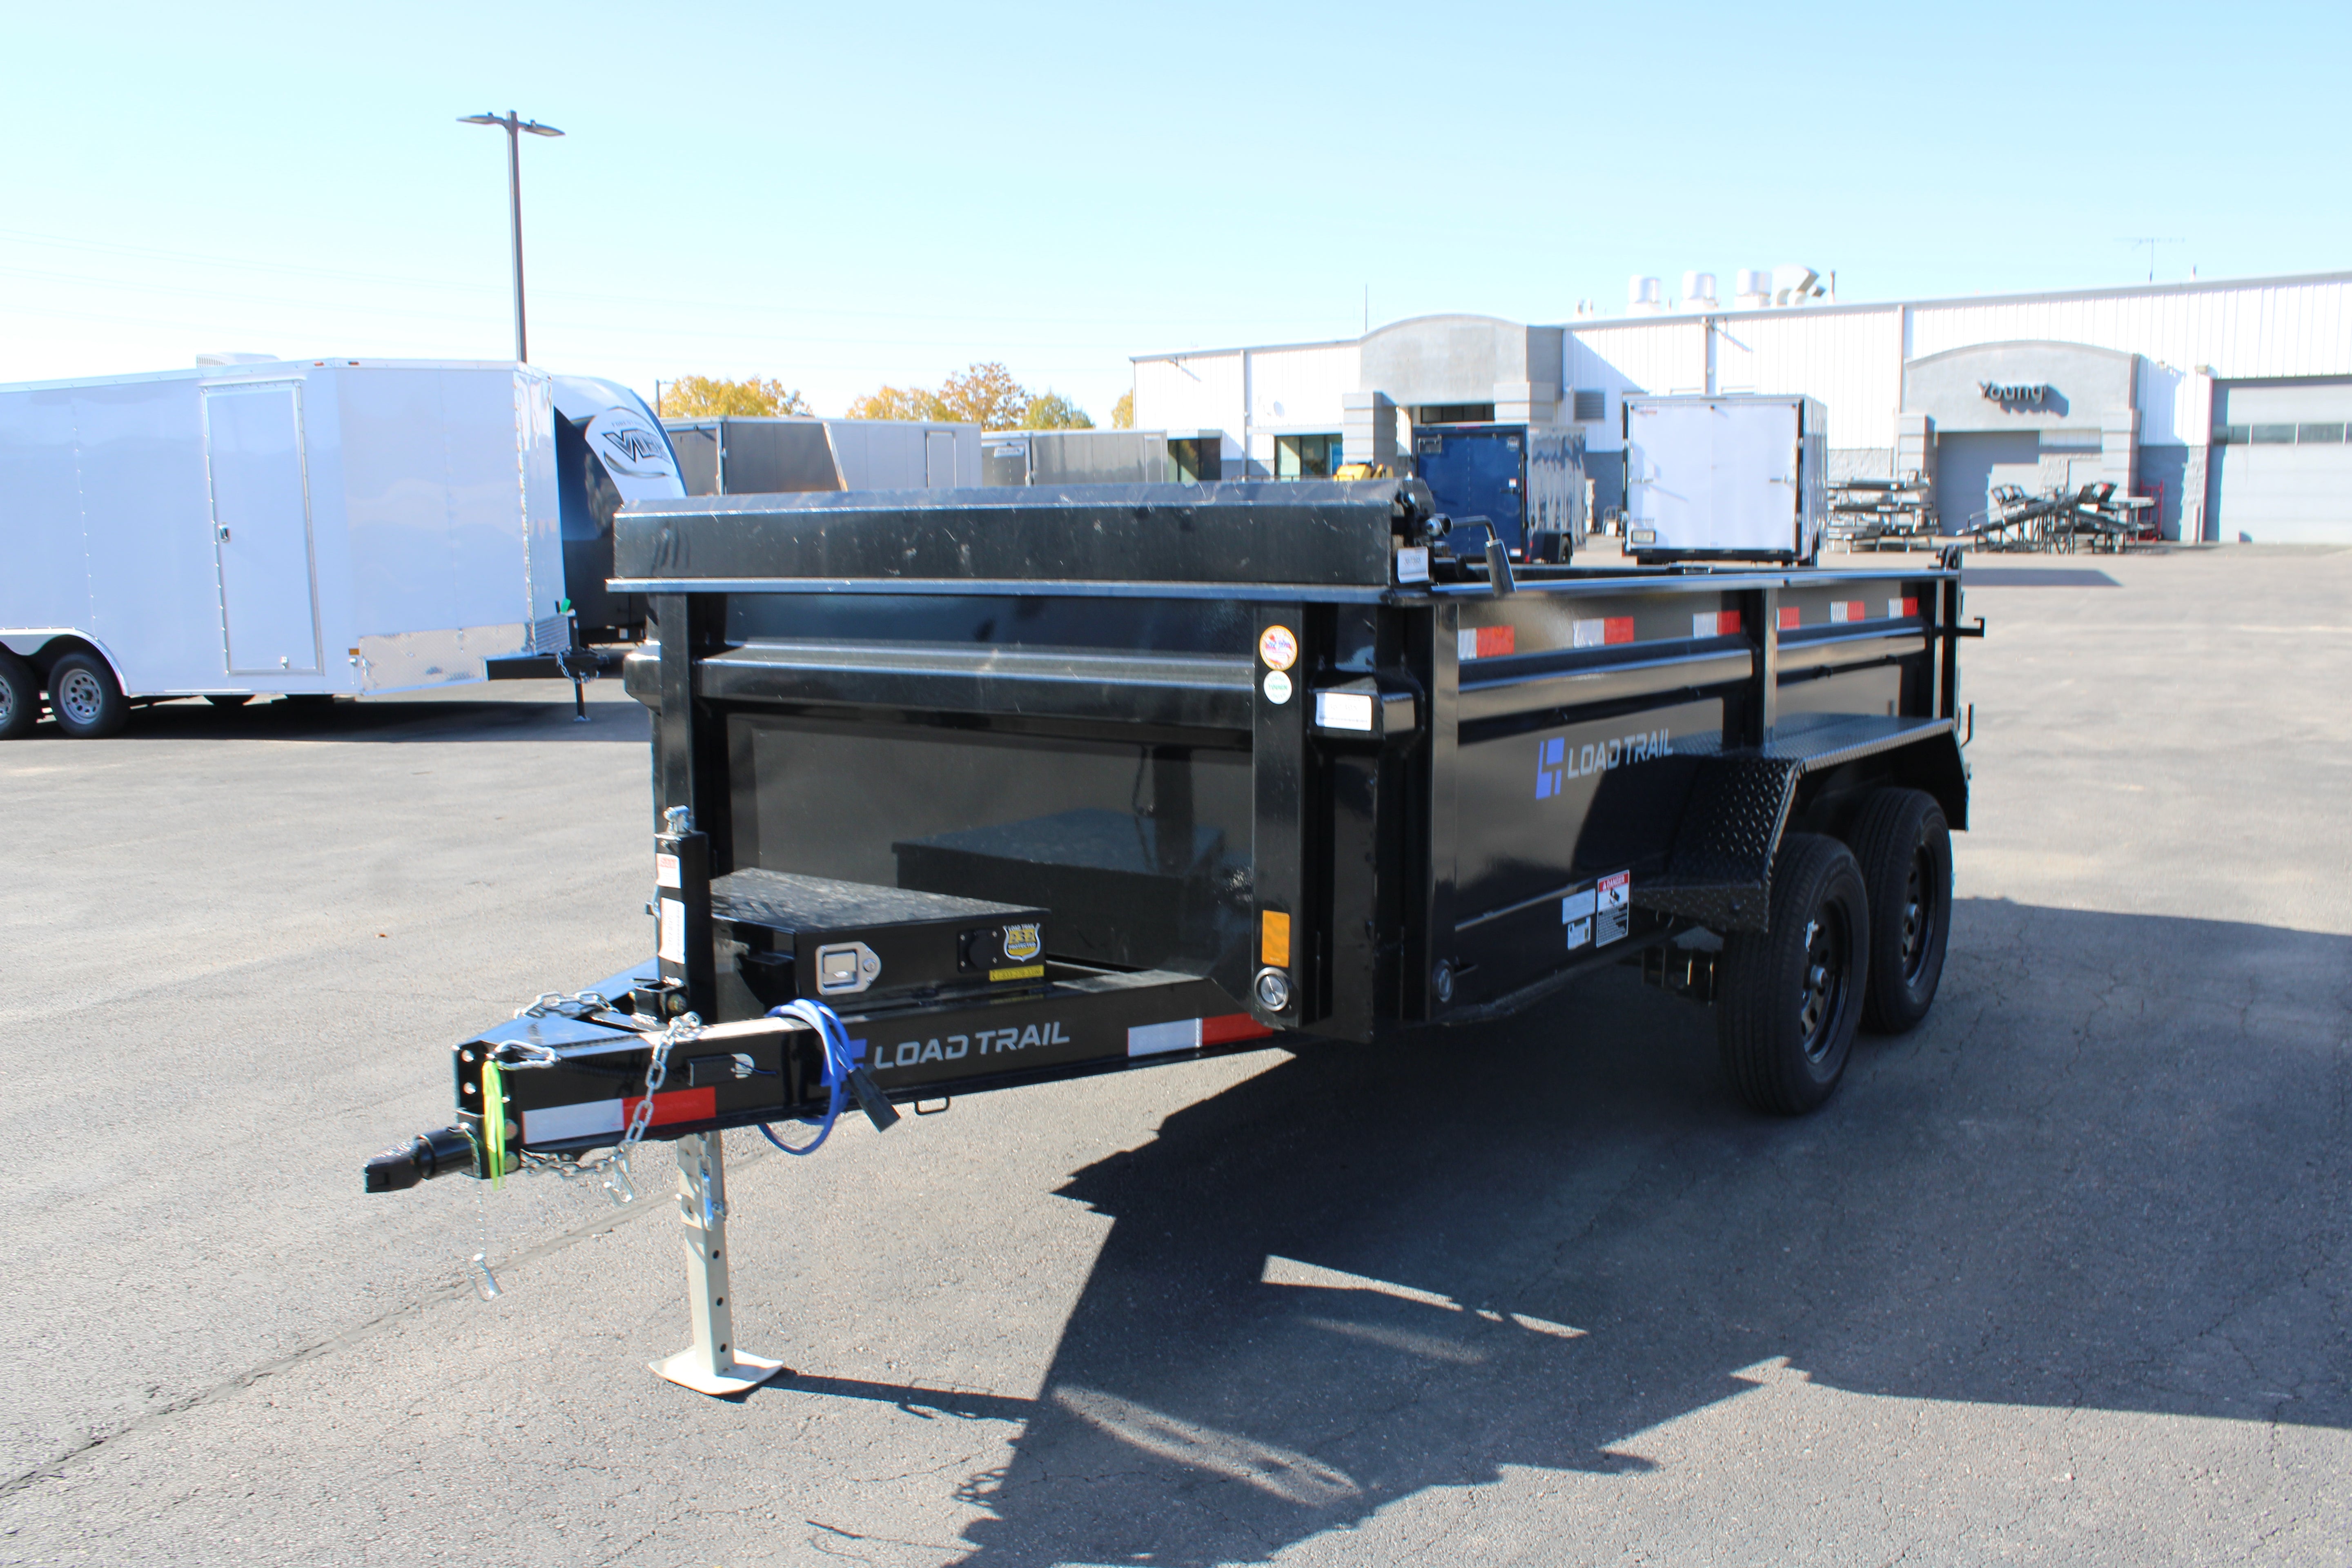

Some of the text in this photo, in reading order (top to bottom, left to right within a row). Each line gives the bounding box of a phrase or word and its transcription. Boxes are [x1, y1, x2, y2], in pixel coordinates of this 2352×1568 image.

[1978, 381, 2044, 404] Young
[1567, 728, 1673, 780] LOAD TRAIL
[1607, 875, 1624, 889] DANGER
[874, 1022, 1070, 1070] LOAD TRAIL
